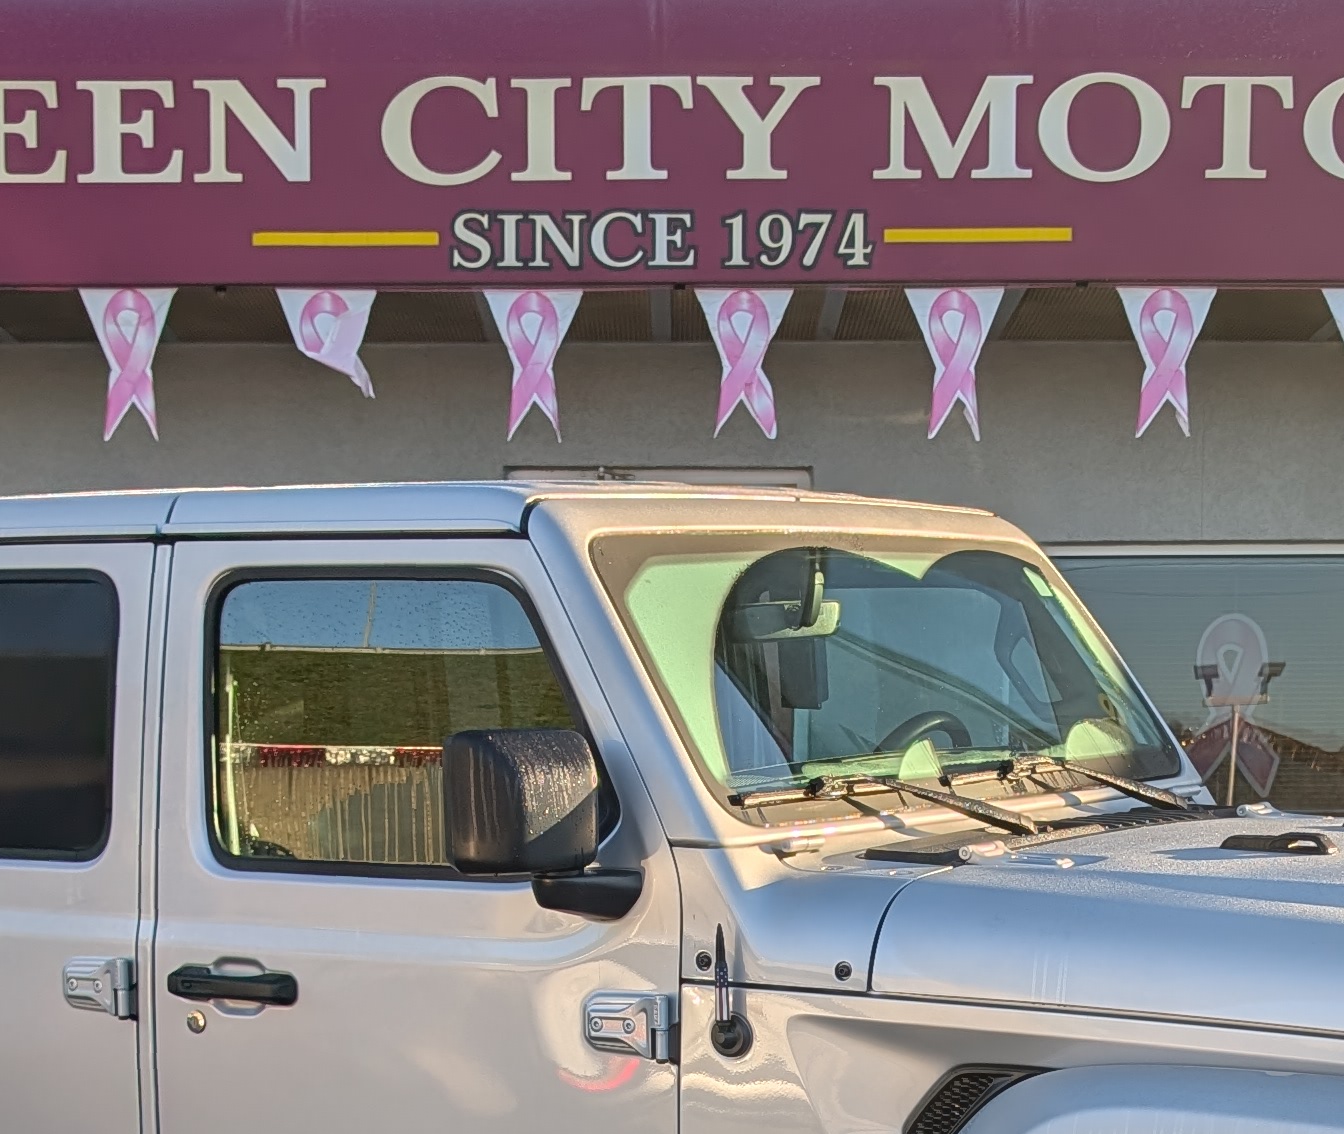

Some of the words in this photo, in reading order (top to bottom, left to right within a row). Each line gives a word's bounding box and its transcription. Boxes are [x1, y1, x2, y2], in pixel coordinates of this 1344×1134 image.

[380, 75, 821, 186] CITY
[451, 210, 696, 270] SINCE
[721, 208, 873, 270] 1974
